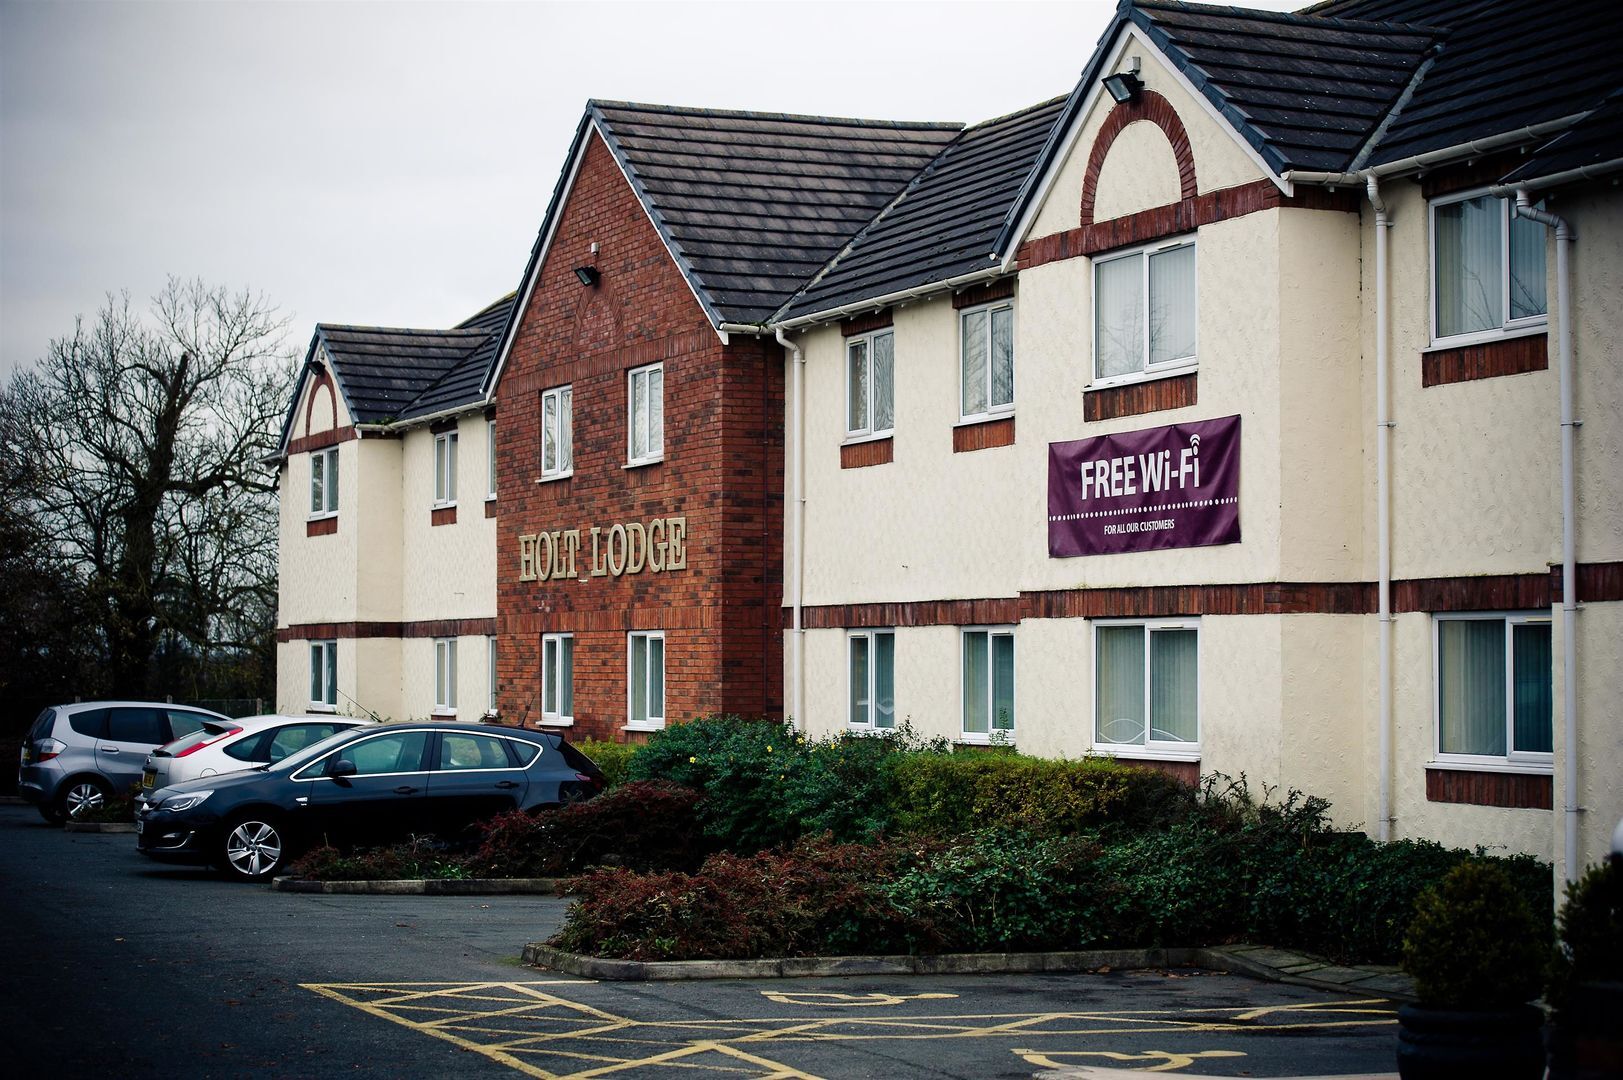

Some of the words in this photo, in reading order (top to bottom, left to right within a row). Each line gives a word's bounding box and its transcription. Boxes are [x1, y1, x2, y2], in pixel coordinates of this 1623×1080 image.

[1081, 455, 1136, 500] FREE
[1139, 444, 1200, 493] Wi-Fi
[518, 529, 581, 582] HOLT
[590, 516, 687, 577] LODGE
[1103, 524, 1116, 535] FOR
[1116, 523, 1126, 534] ALL
[1126, 522, 1140, 533] OUR
[1139, 519, 1175, 532] CUSTOMERS
